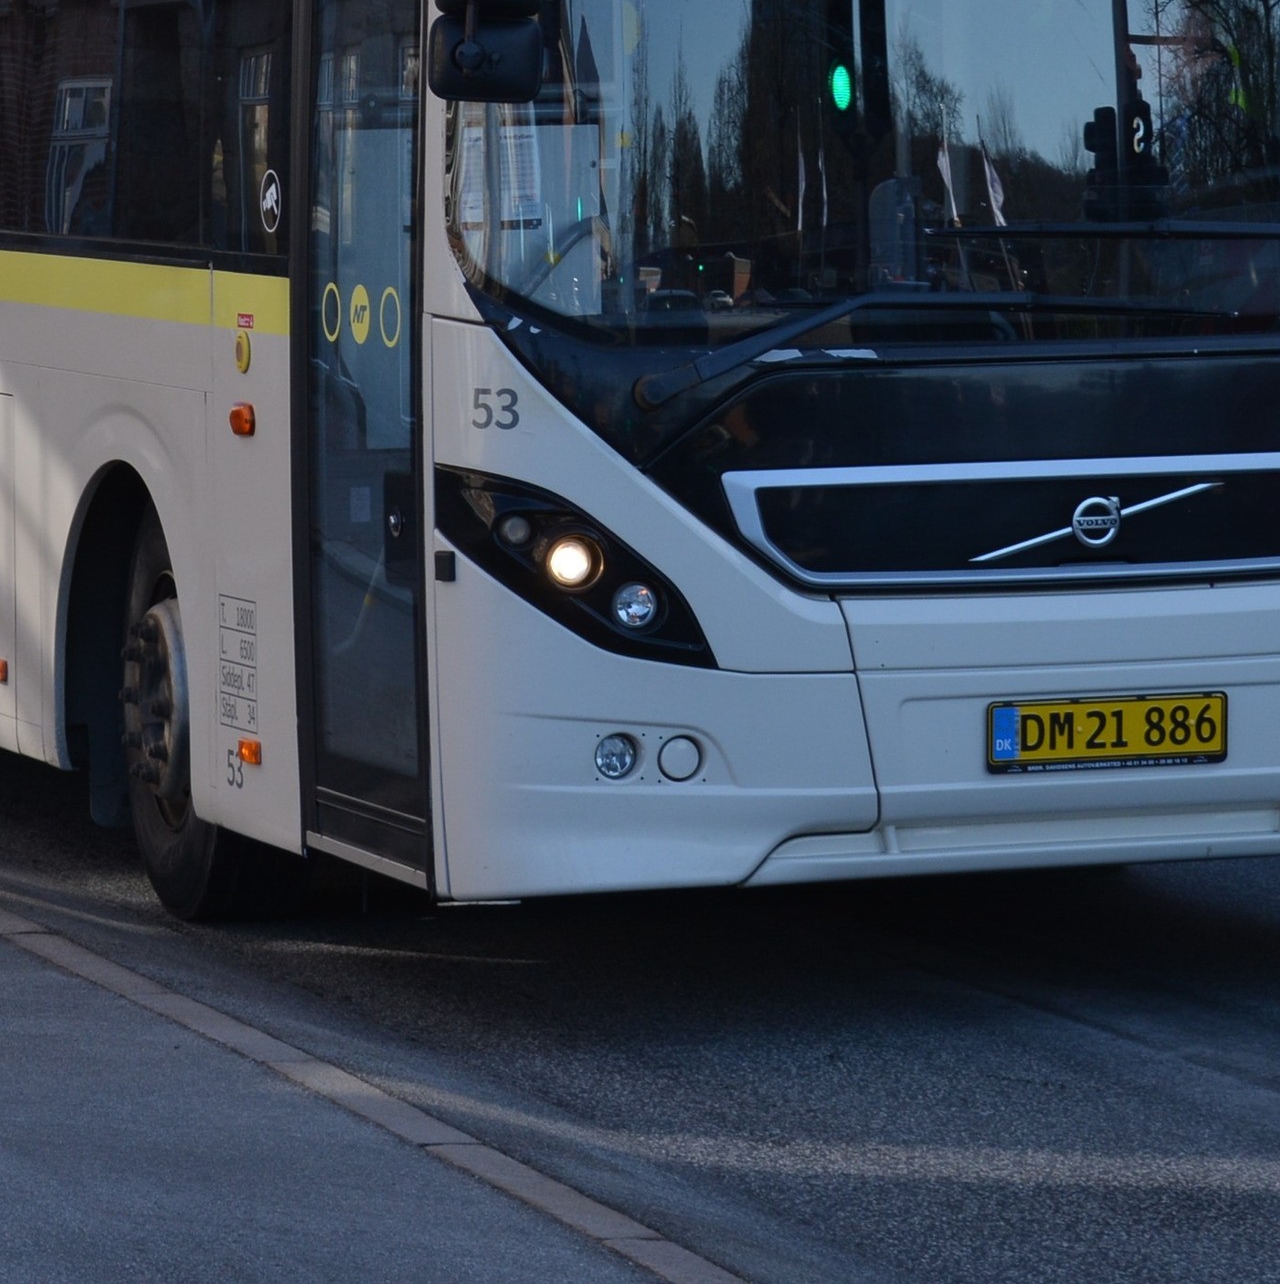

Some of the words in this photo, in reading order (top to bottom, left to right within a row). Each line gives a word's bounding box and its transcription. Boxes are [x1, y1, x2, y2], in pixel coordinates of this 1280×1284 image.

[353, 304, 367, 324] NT
[471, 387, 520, 430] 53
[996, 739, 1012, 752] DK
[1020, 711, 1074, 752] DM
[1086, 710, 1128, 749] 21
[1144, 704, 1218, 746] 886
[227, 748, 244, 789] 53
